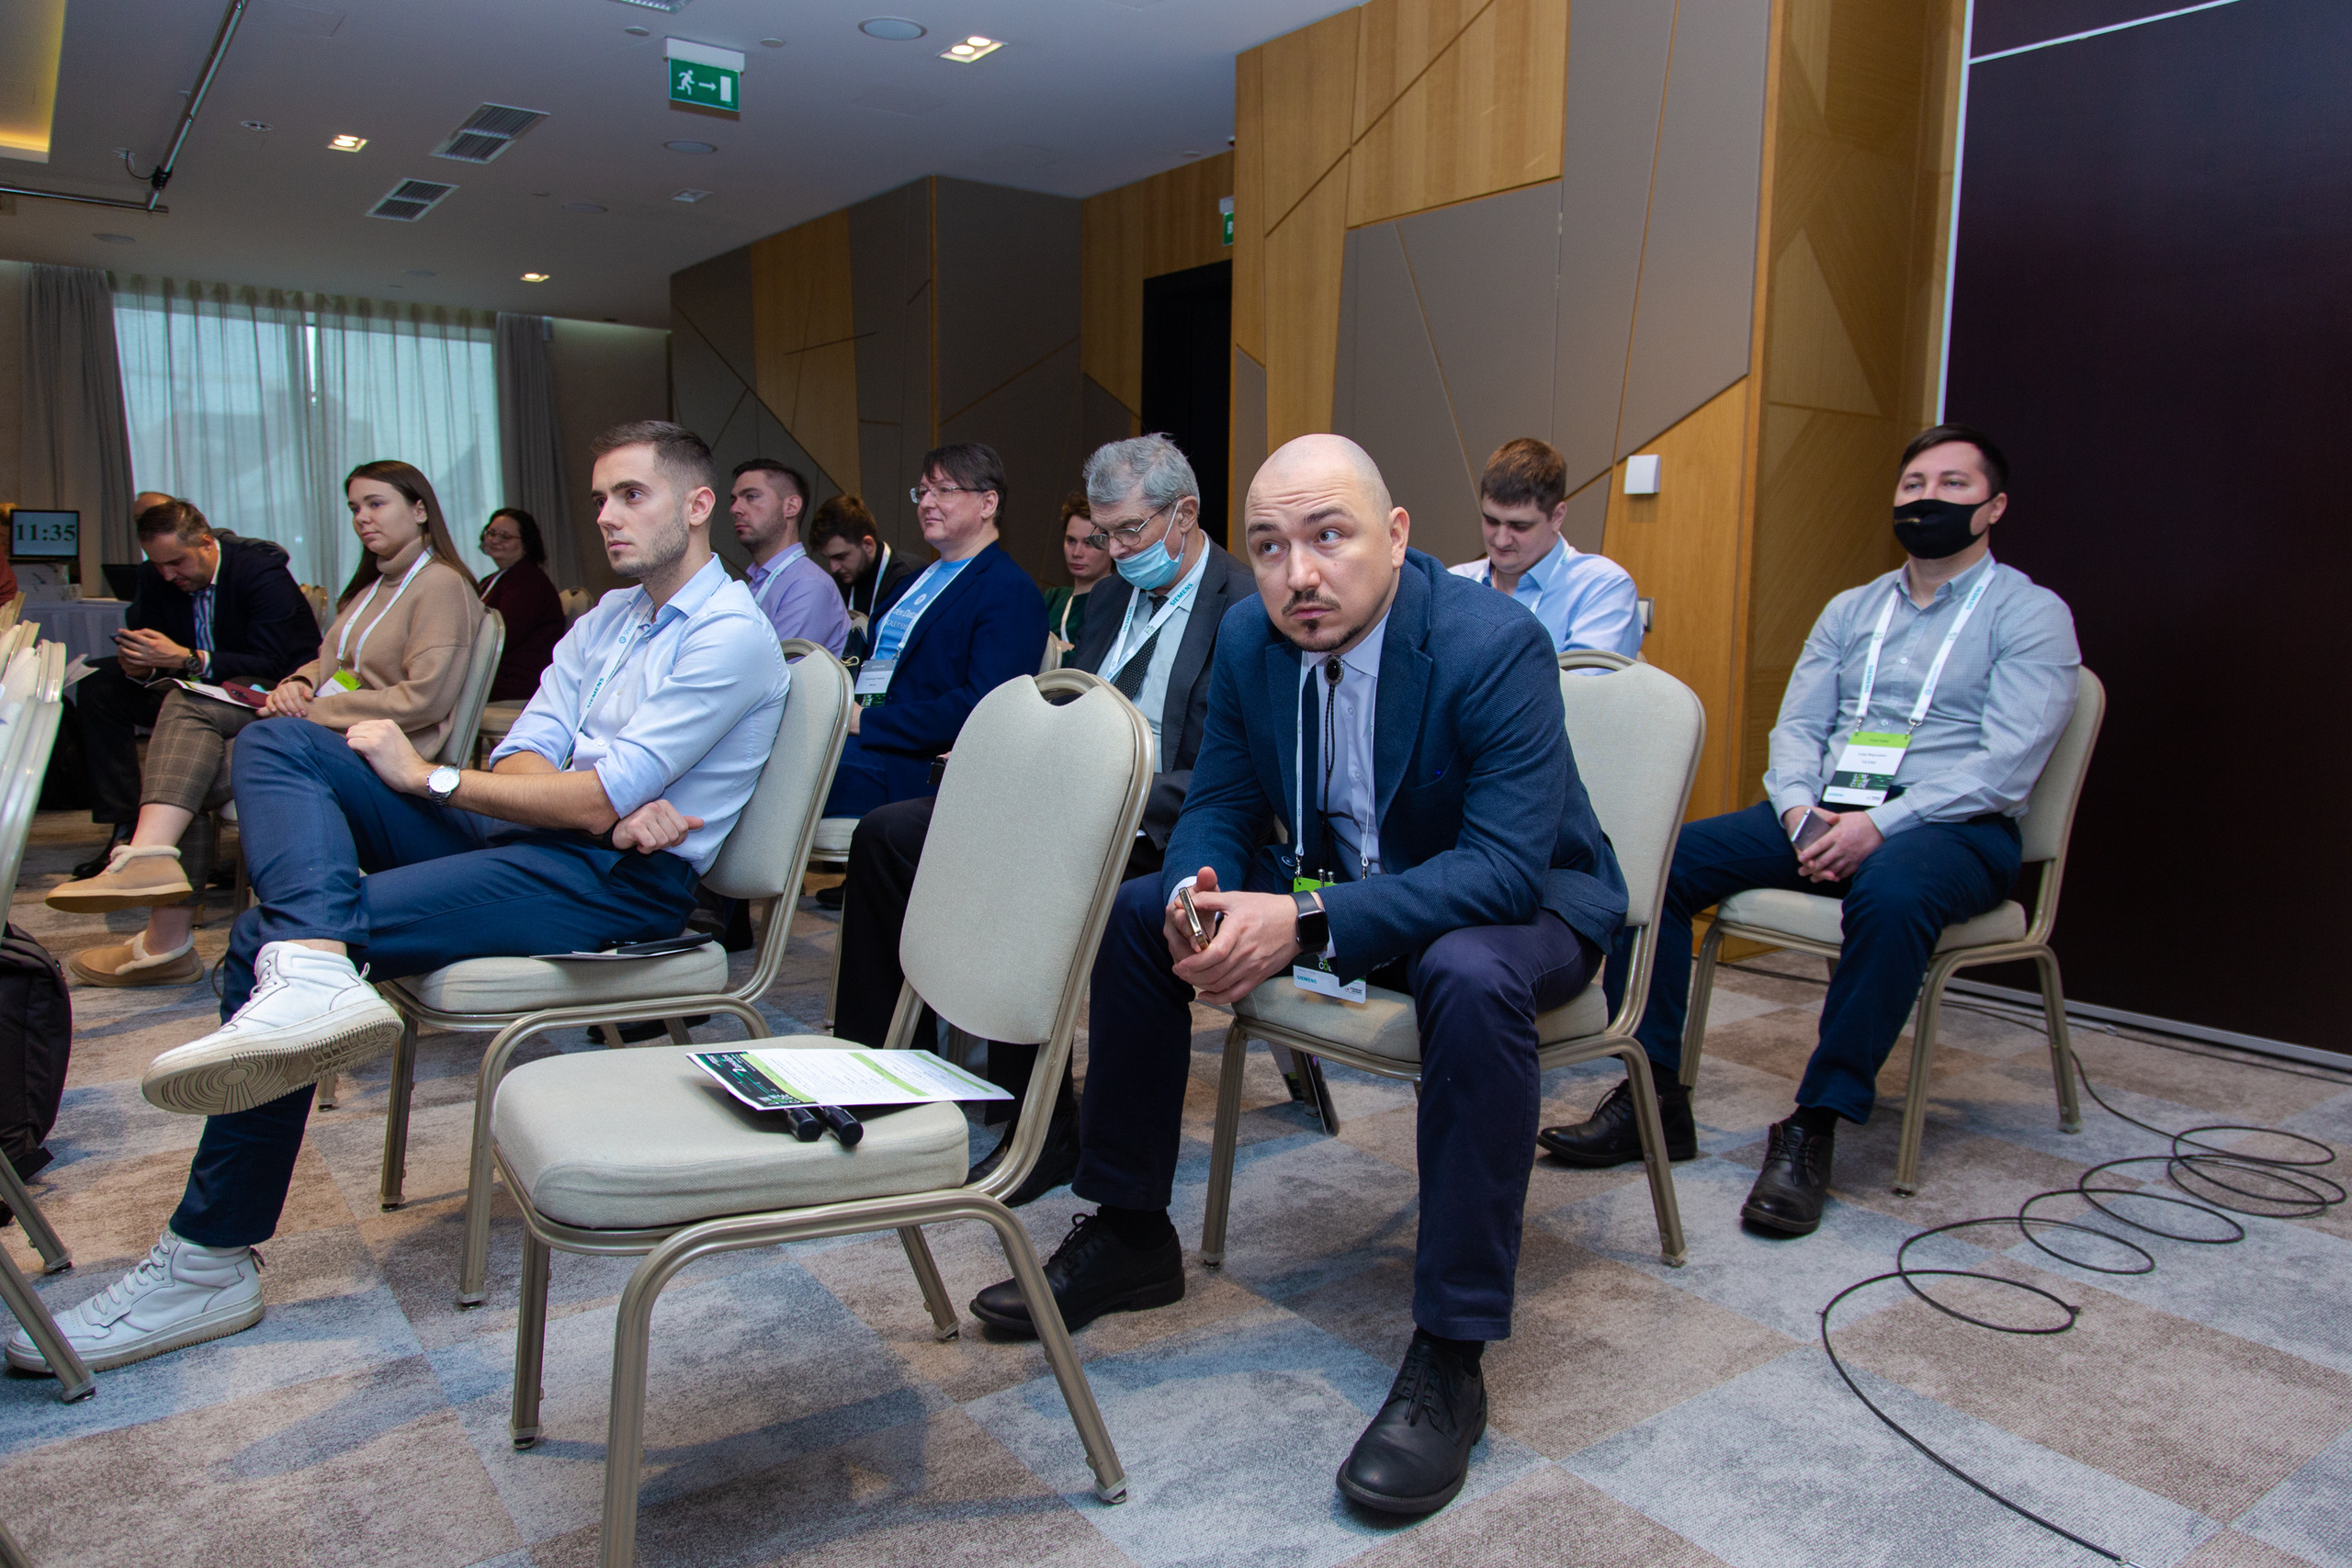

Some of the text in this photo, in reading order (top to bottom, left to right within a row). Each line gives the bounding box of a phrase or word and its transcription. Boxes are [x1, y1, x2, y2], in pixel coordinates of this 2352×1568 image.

[17, 524, 76, 542] 11:35
[1170, 582, 1193, 606] SIEMENS
[1965, 586, 1983, 610] SIEMENS
[1123, 605, 1134, 633] SIEMENS
[1864, 664, 1874, 694] SIEMENS
[587, 678, 604, 708] SIEMENS
[1318, 962, 1332, 972] CO
[1296, 975, 1317, 985] SIEMENS
